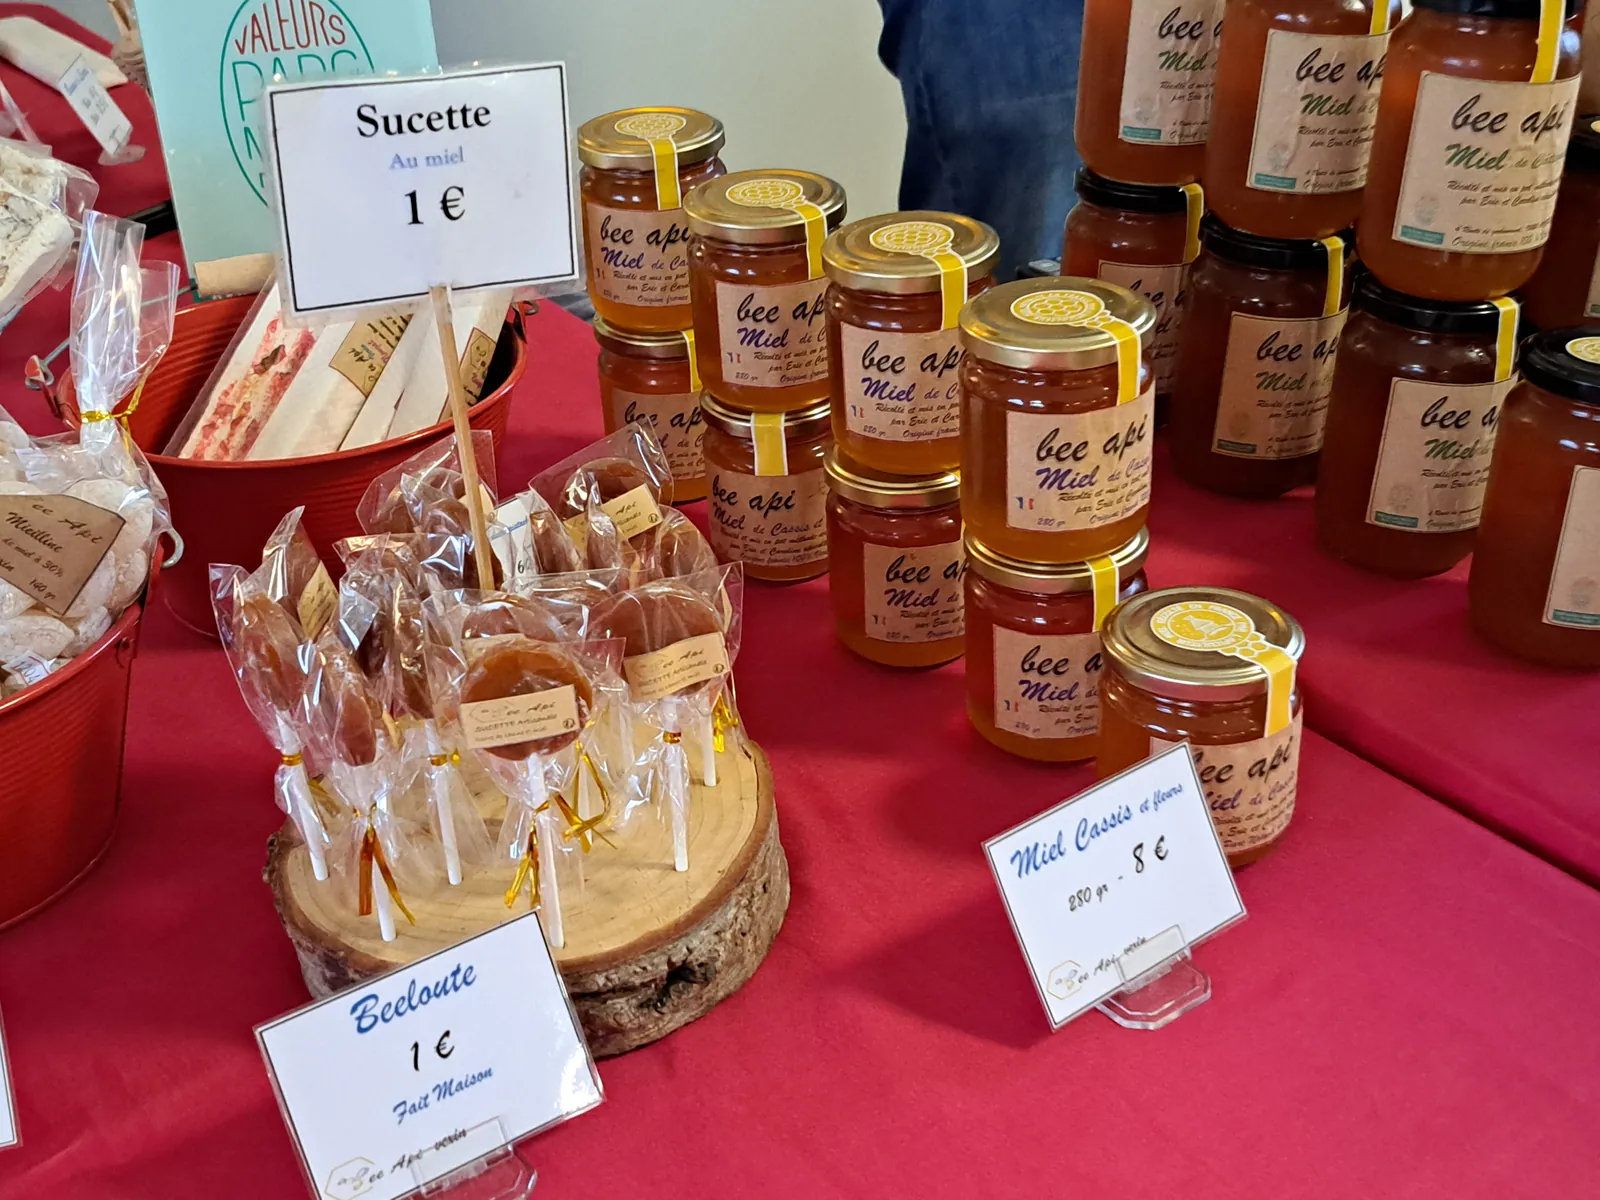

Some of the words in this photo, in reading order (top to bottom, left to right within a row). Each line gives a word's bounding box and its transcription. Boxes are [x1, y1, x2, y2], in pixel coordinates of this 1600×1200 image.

[1158, 6, 1204, 40] bee
[1295, 47, 1346, 83] bee
[1300, 93, 1356, 116] Miel
[1452, 93, 1509, 133] bee
[1520, 100, 1569, 143] api
[356, 104, 492, 138] Sucette
[389, 153, 418, 169] Au
[425, 145, 465, 167] miel
[1444, 143, 1509, 171] Miel
[405, 190, 424, 225] 1
[440, 186, 465, 221] €
[601, 215, 634, 244] bee
[601, 247, 644, 269] Miel
[651, 260, 664, 270] de
[737, 293, 780, 323] bee
[737, 328, 789, 348] Miel
[798, 333, 812, 344] de
[1257, 331, 1302, 362] bee
[861, 340, 906, 374] bee
[861, 377, 916, 402] Miel
[924, 388, 940, 400] de
[1255, 371, 1308, 391] Miel
[1420, 396, 1471, 429] bee
[1036, 428, 1088, 462] bee
[1102, 414, 1148, 461] api
[1424, 438, 1480, 460] Miel
[1036, 465, 1100, 490] Miel
[1107, 471, 1122, 482] de
[713, 474, 738, 506] bee
[749, 489, 796, 518] api
[57, 518, 103, 544] Api
[713, 501, 746, 530] Miel
[753, 525, 764, 534] de
[771, 523, 809, 536] Cassis
[886, 555, 931, 583] bee
[884, 588, 940, 608] Miel
[1021, 645, 1069, 675] bee
[1019, 680, 1079, 702] Miel
[1248, 736, 1293, 784] api
[1207, 788, 1243, 811] iel
[1010, 830, 1066, 878] Miel
[1075, 805, 1132, 852] Cassis
[1139, 798, 1150, 813] et
[1151, 783, 1183, 811] fleurs
[1068, 887, 1092, 912] 280
[1133, 842, 1144, 873] 8
[1154, 835, 1169, 861] €
[350, 963, 477, 1034] Beeloute
[410, 1040, 420, 1072] 1
[434, 1029, 455, 1059] €
[392, 1093, 430, 1125] Fait
[432, 1068, 493, 1102] Maison
[391, 1149, 423, 1174] Api
